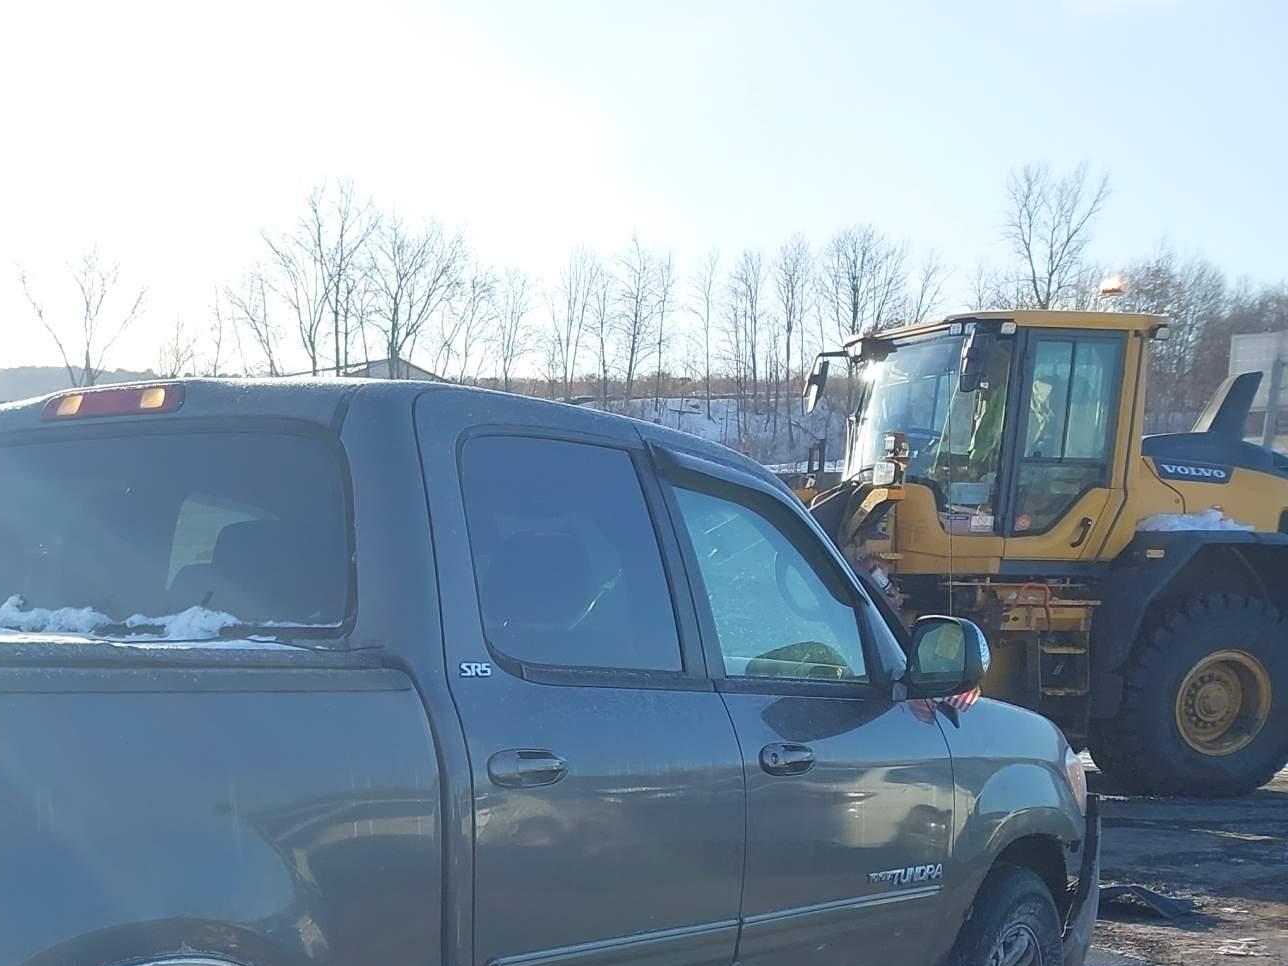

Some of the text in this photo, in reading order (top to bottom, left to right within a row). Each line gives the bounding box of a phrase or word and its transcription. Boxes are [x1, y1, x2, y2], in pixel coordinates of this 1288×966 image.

[1160, 464, 1226, 478] VOLVO
[460, 662, 491, 676] SR5
[890, 863, 943, 885] TUNDRA
